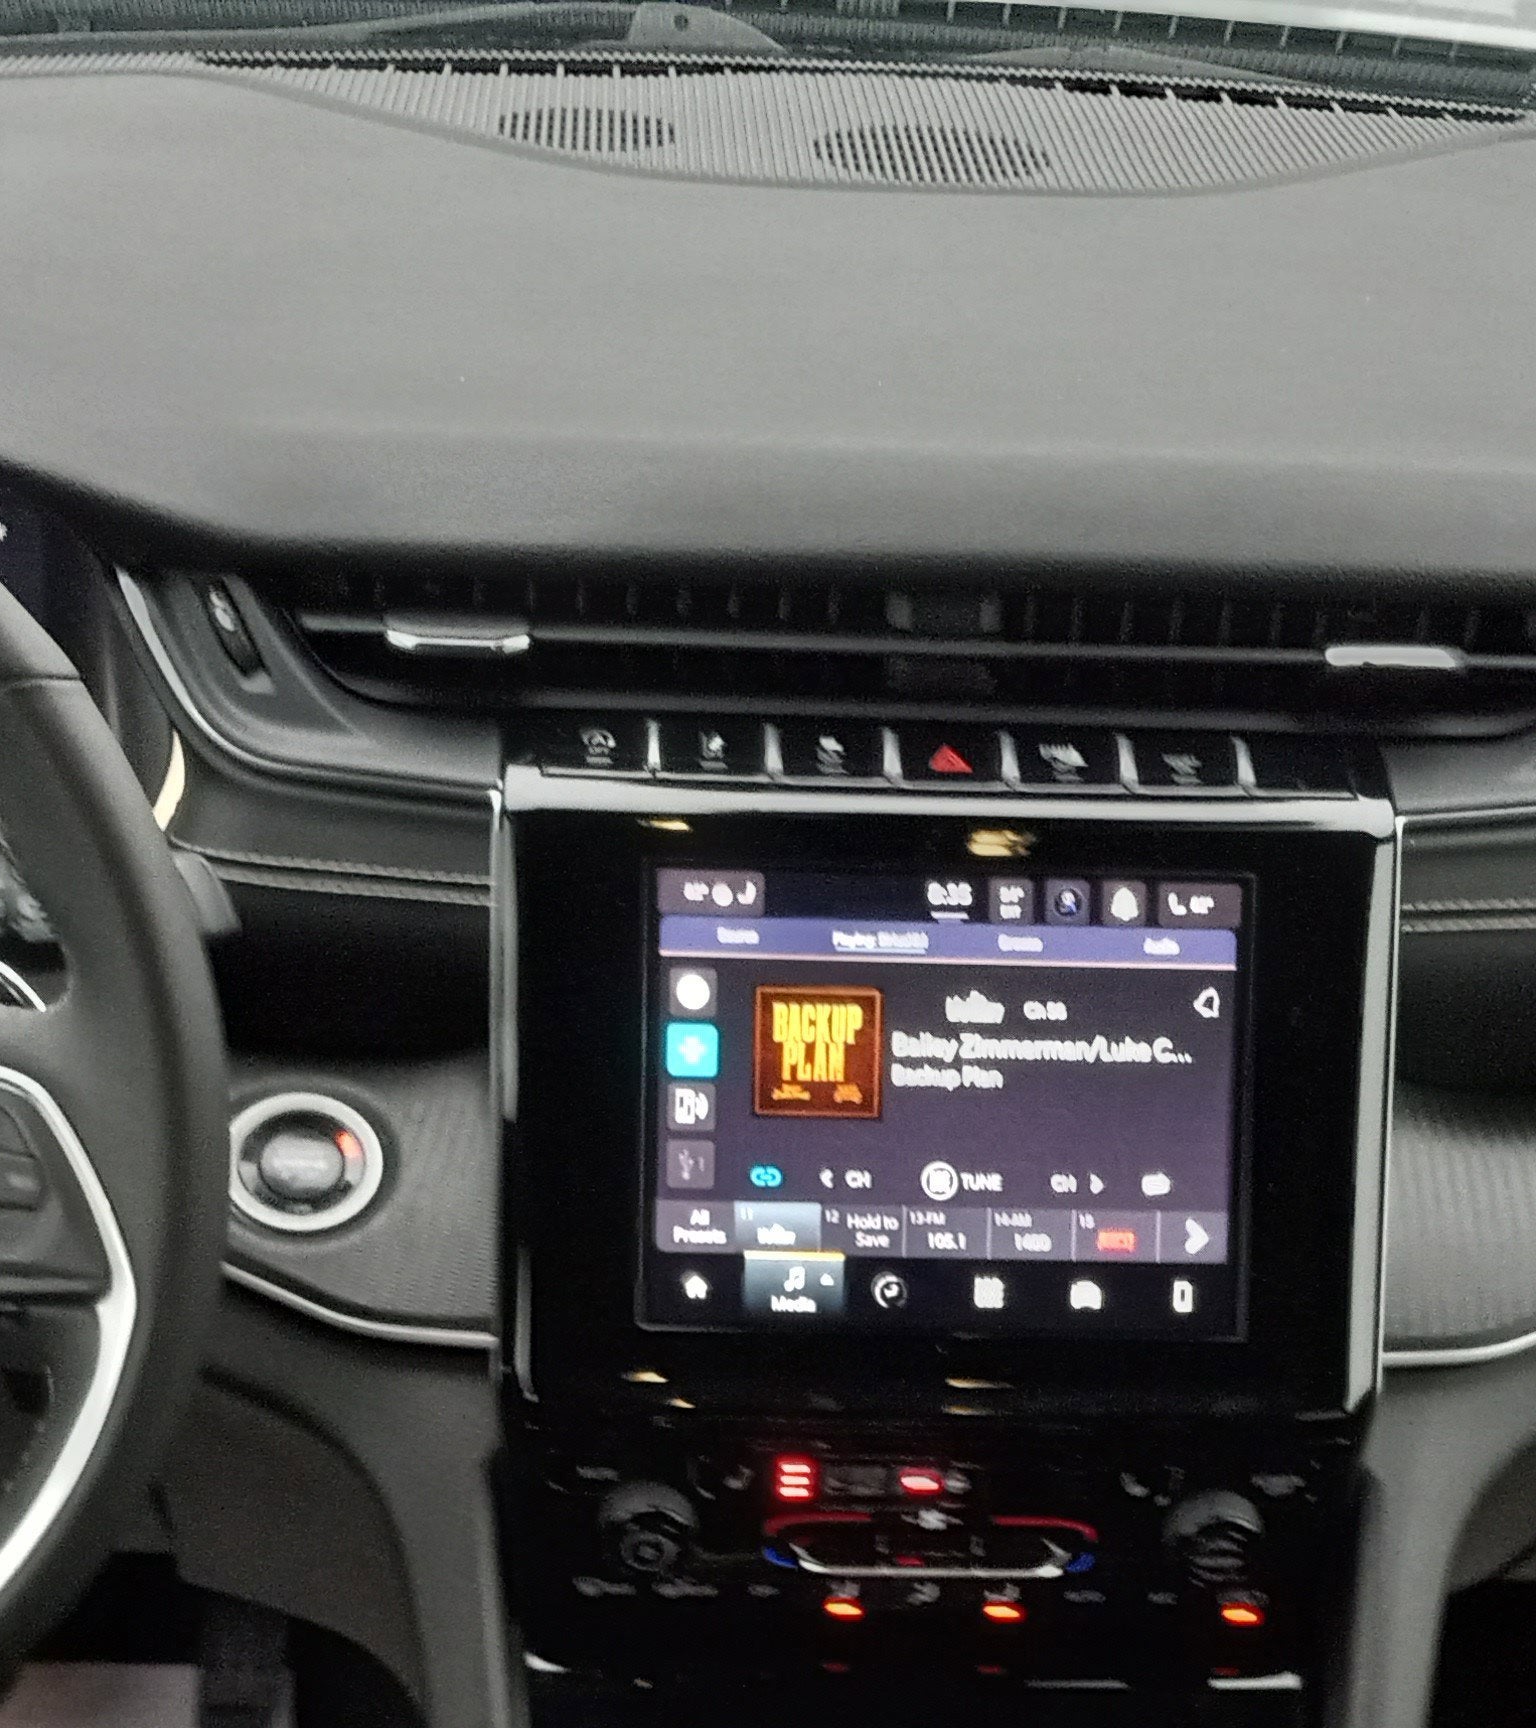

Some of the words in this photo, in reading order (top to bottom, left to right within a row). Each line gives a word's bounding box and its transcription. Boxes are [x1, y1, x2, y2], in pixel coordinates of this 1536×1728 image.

[772, 1001, 863, 1045] BACKUP
[781, 1042, 845, 1082] PLAN
[960, 1172, 1004, 1192] TUNE
[824, 1208, 841, 1225] 12
[846, 1212, 882, 1232] Hold
[882, 1212, 900, 1231] to
[854, 1231, 891, 1249] Save
